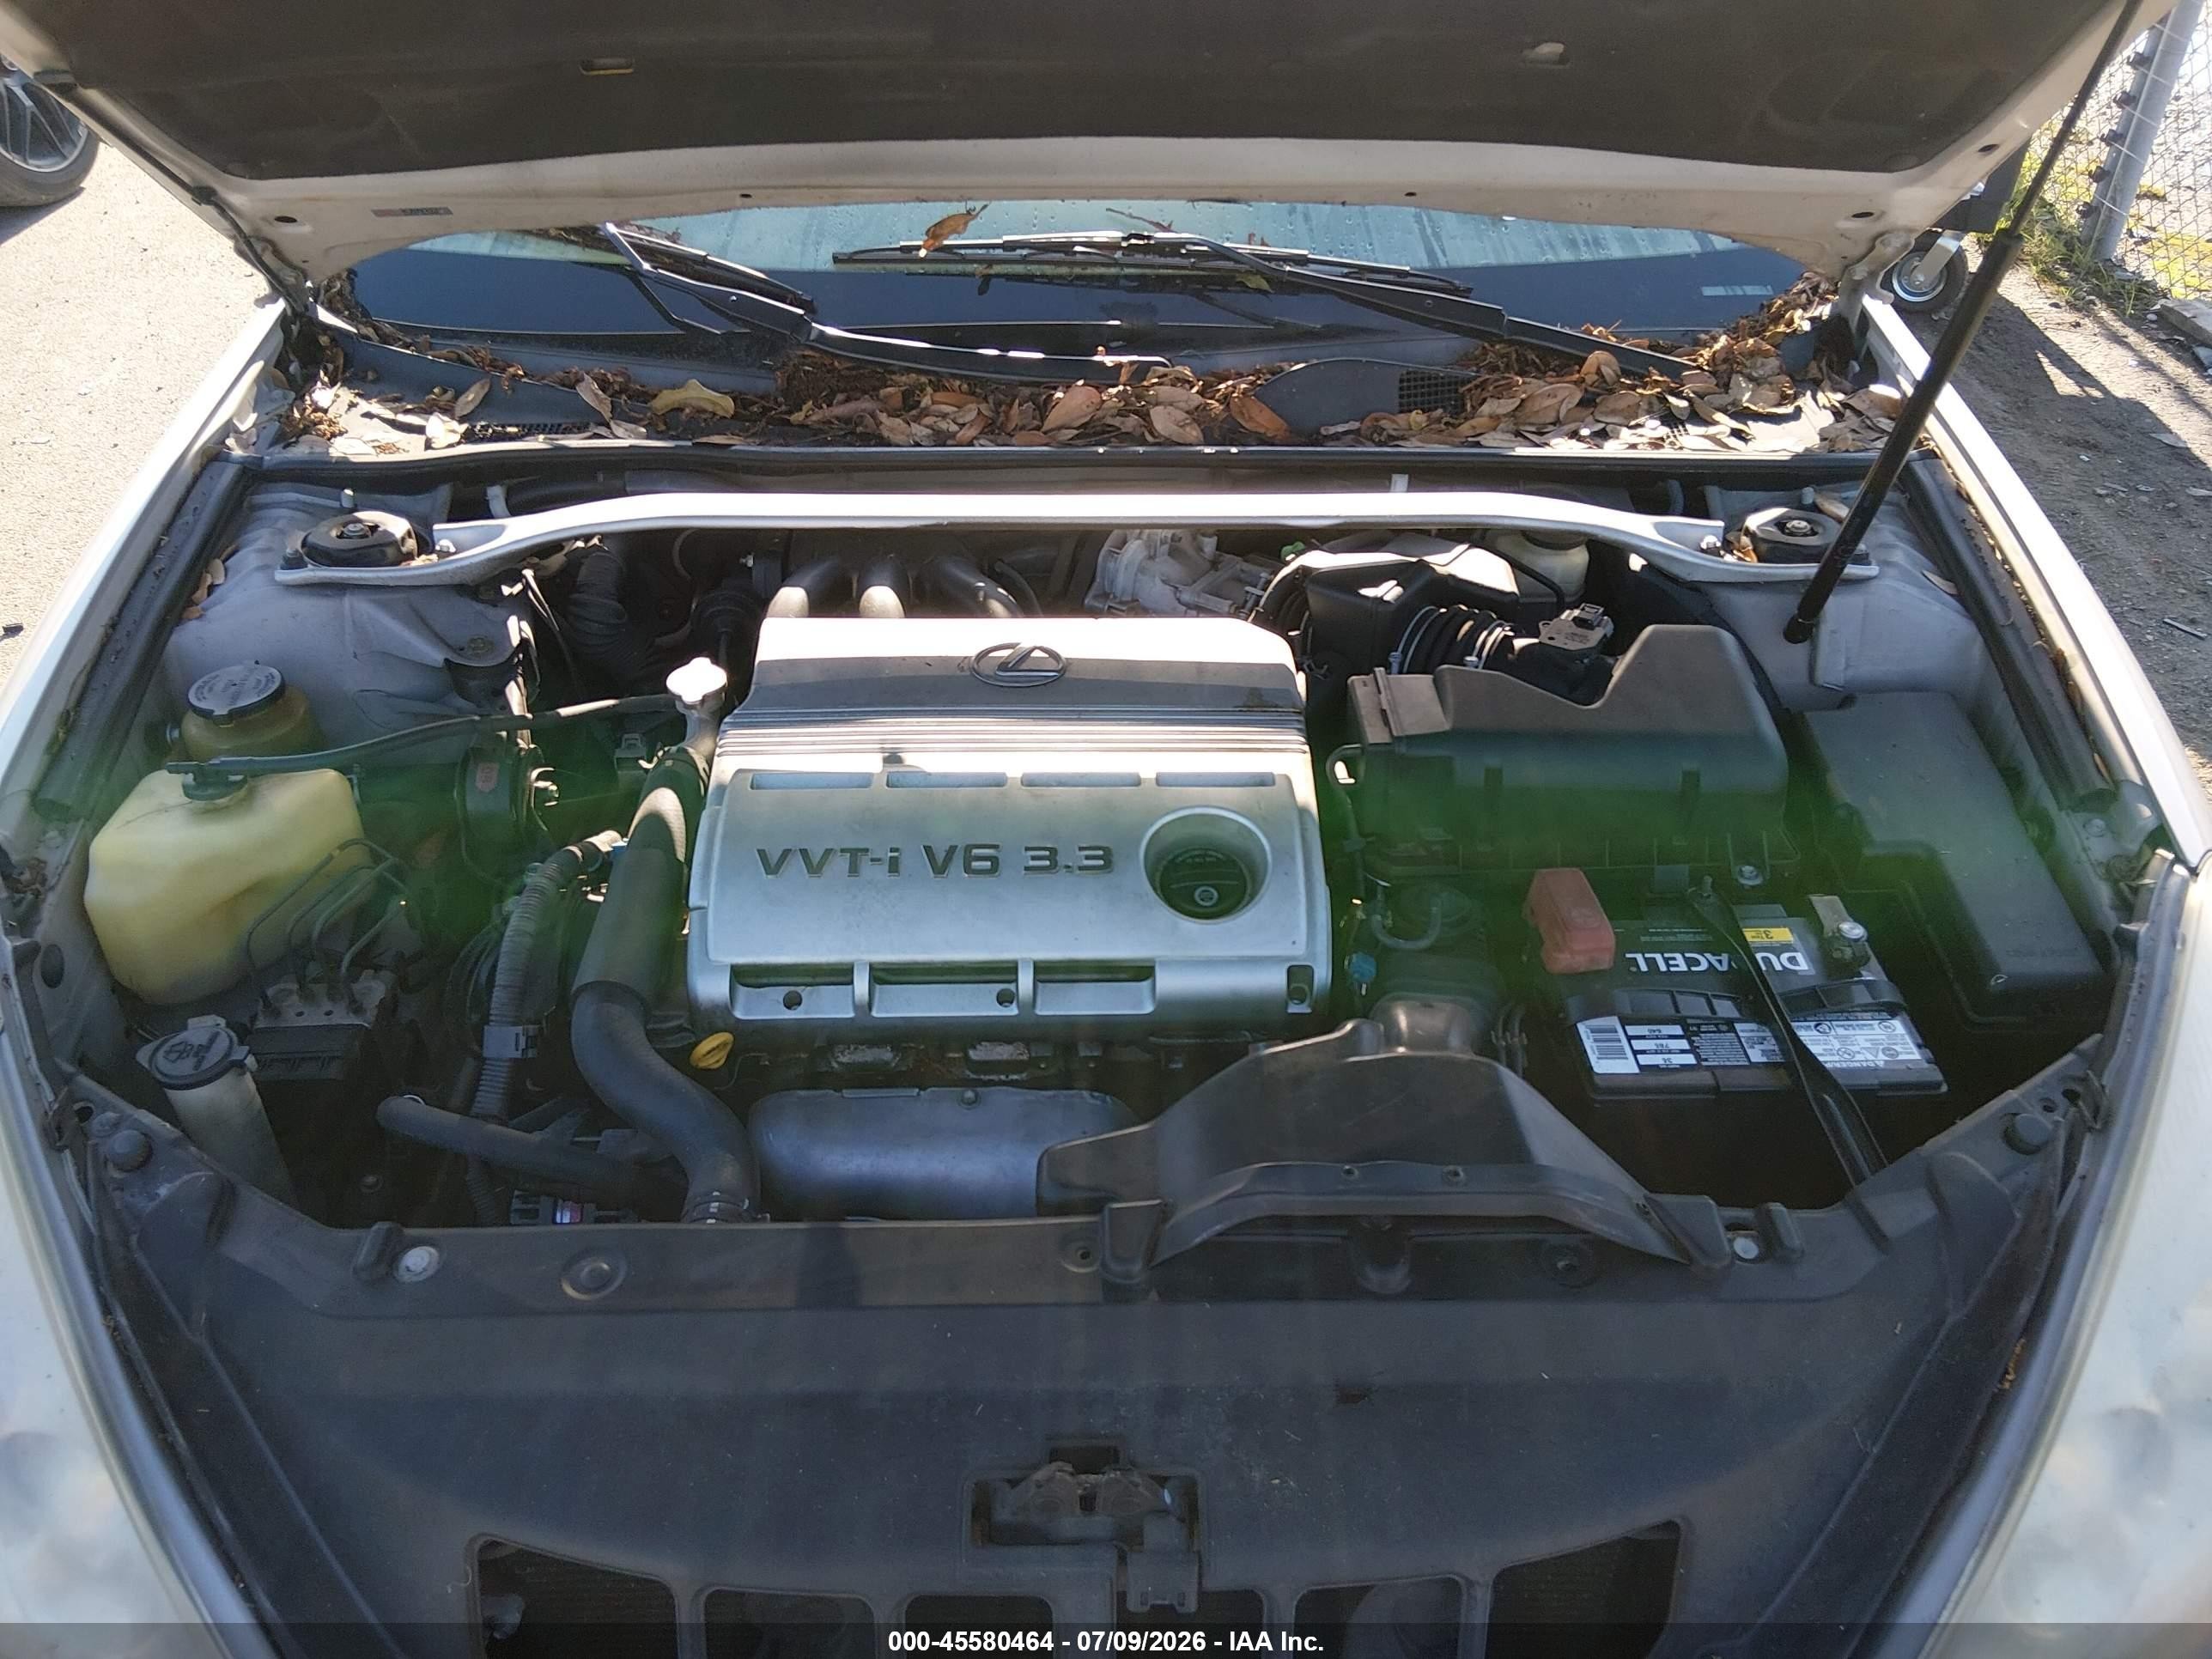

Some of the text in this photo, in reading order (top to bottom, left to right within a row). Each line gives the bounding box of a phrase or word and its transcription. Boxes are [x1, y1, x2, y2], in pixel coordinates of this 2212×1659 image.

[756, 843, 1115, 878] VVT-i V6 3.3
[1625, 951, 1809, 971] DUACELL
